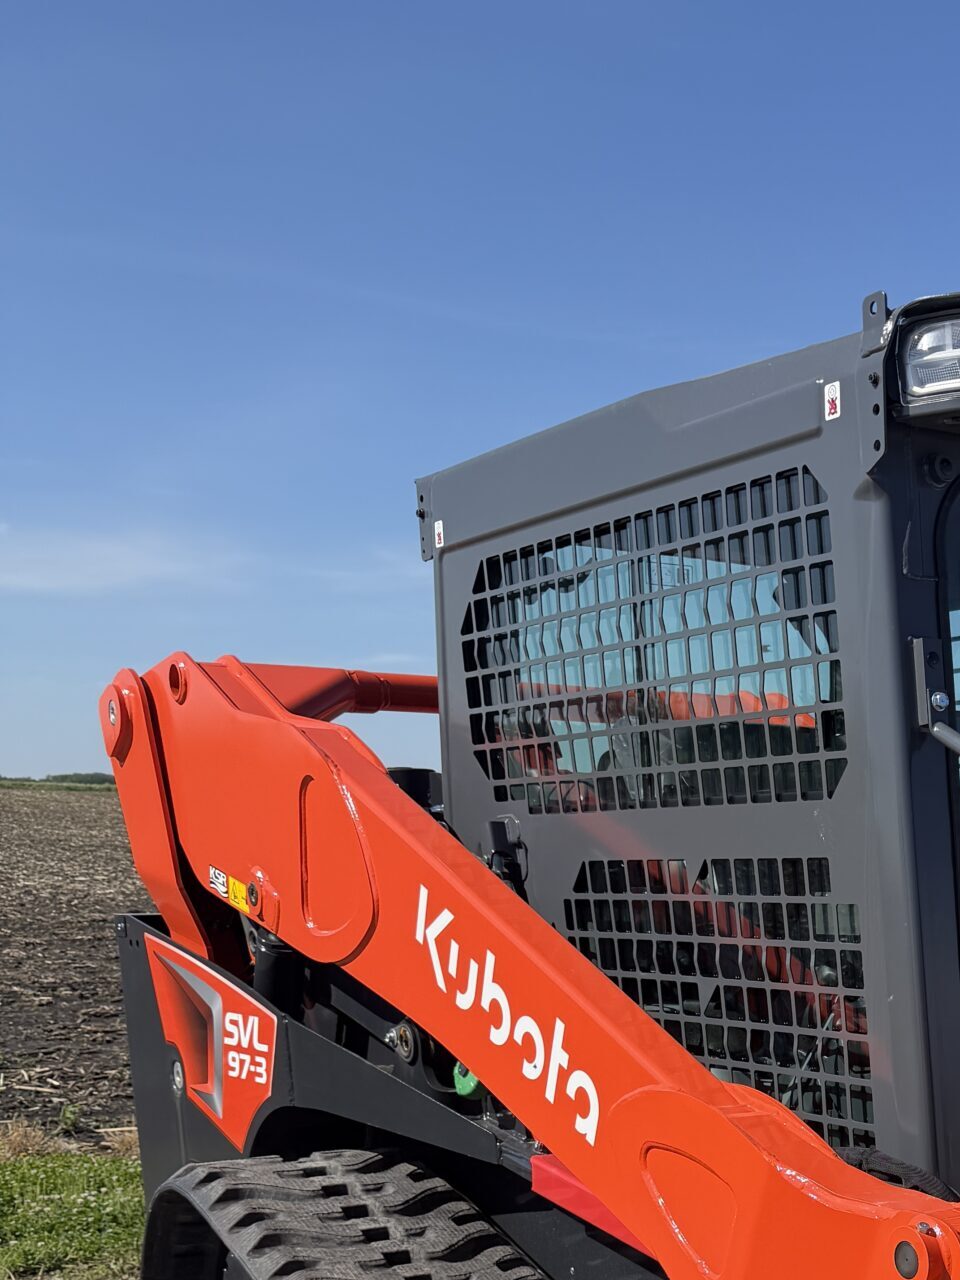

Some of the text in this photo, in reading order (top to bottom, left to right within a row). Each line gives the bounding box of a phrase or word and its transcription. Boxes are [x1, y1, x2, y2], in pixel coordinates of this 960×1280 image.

[209, 865, 227, 888] KSR
[224, 1011, 269, 1053] SVL
[415, 884, 600, 1147] Kubota
[227, 1050, 268, 1085] 97-3
